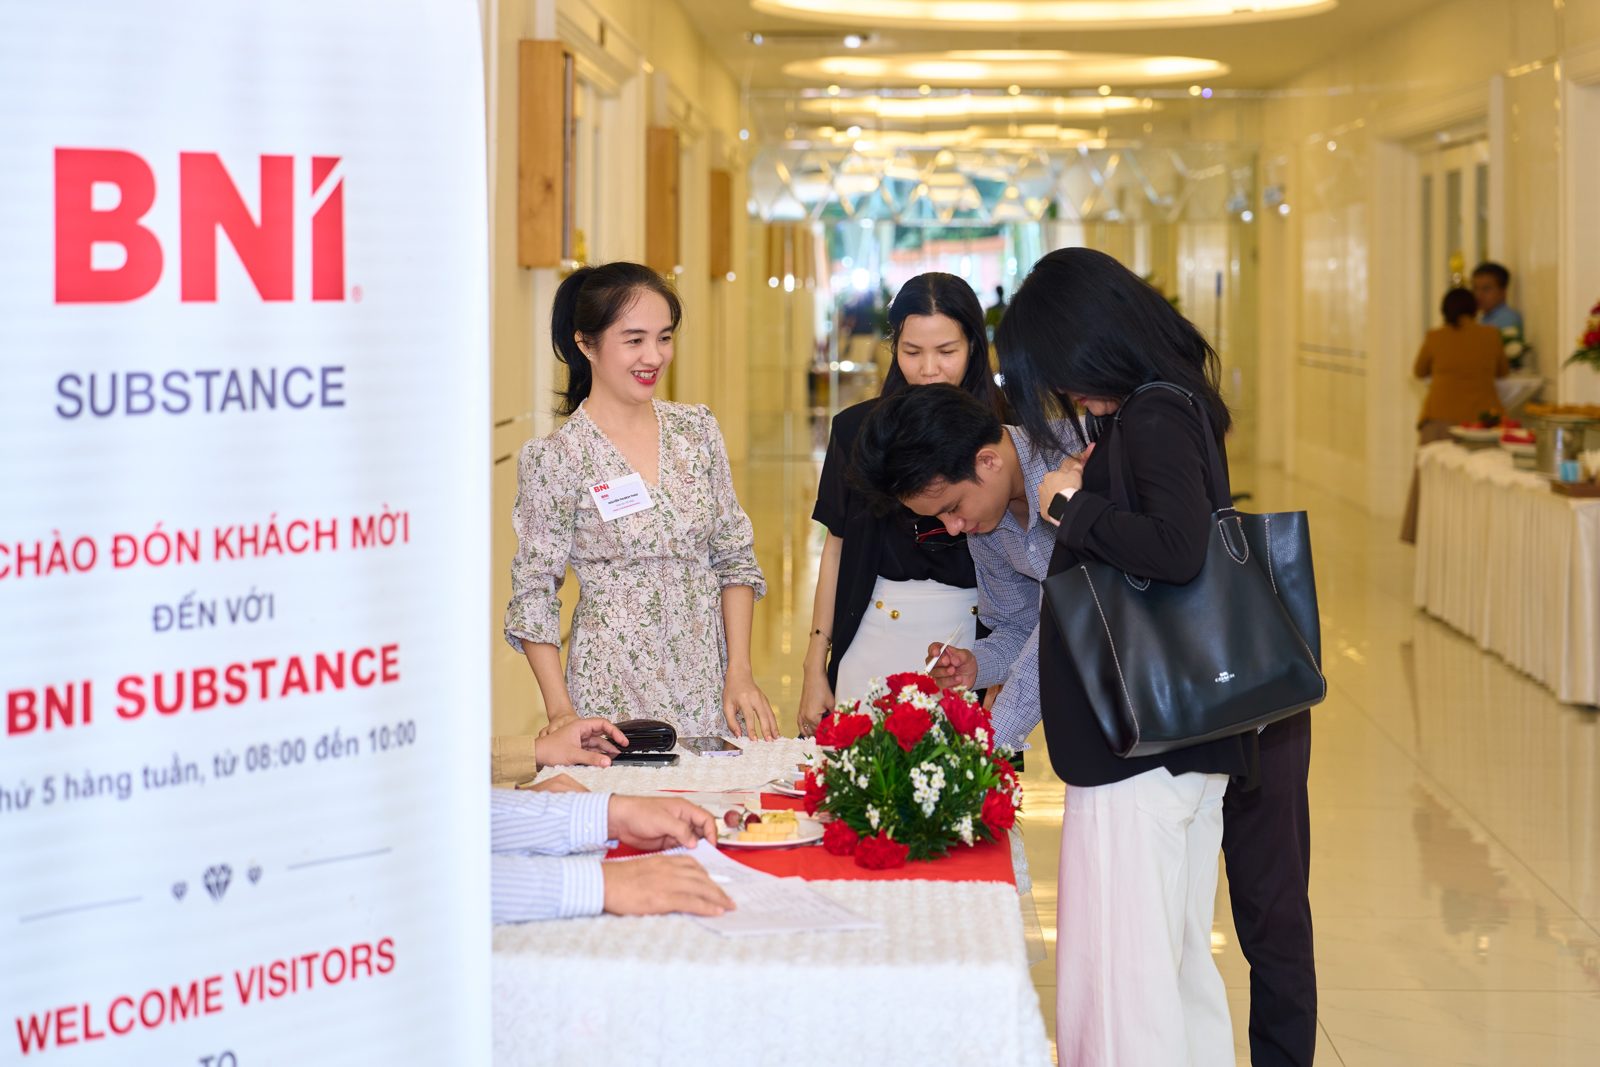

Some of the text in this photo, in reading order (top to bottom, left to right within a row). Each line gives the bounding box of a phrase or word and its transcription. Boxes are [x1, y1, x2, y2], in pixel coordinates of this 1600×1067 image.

[54, 147, 345, 304] BNI
[55, 366, 346, 419] SUBSTANCE
[593, 483, 609, 493] BNI
[111, 522, 201, 569] ĐÓN
[213, 513, 338, 562] KHÁCH
[351, 504, 410, 550] MỜI
[152, 587, 275, 632] ĐẾN VỚI
[7, 644, 401, 737] BNI SUBSTANCE
[0, 778, 34, 813] hứ
[42, 774, 56, 805] 5
[64, 769, 132, 801] hàng
[213, 750, 239, 778] từ
[245, 737, 306, 772] 08:00
[314, 725, 359, 760] đến
[369, 719, 416, 753] 10:00
[15, 937, 396, 1055] WELCOME VISITORS
